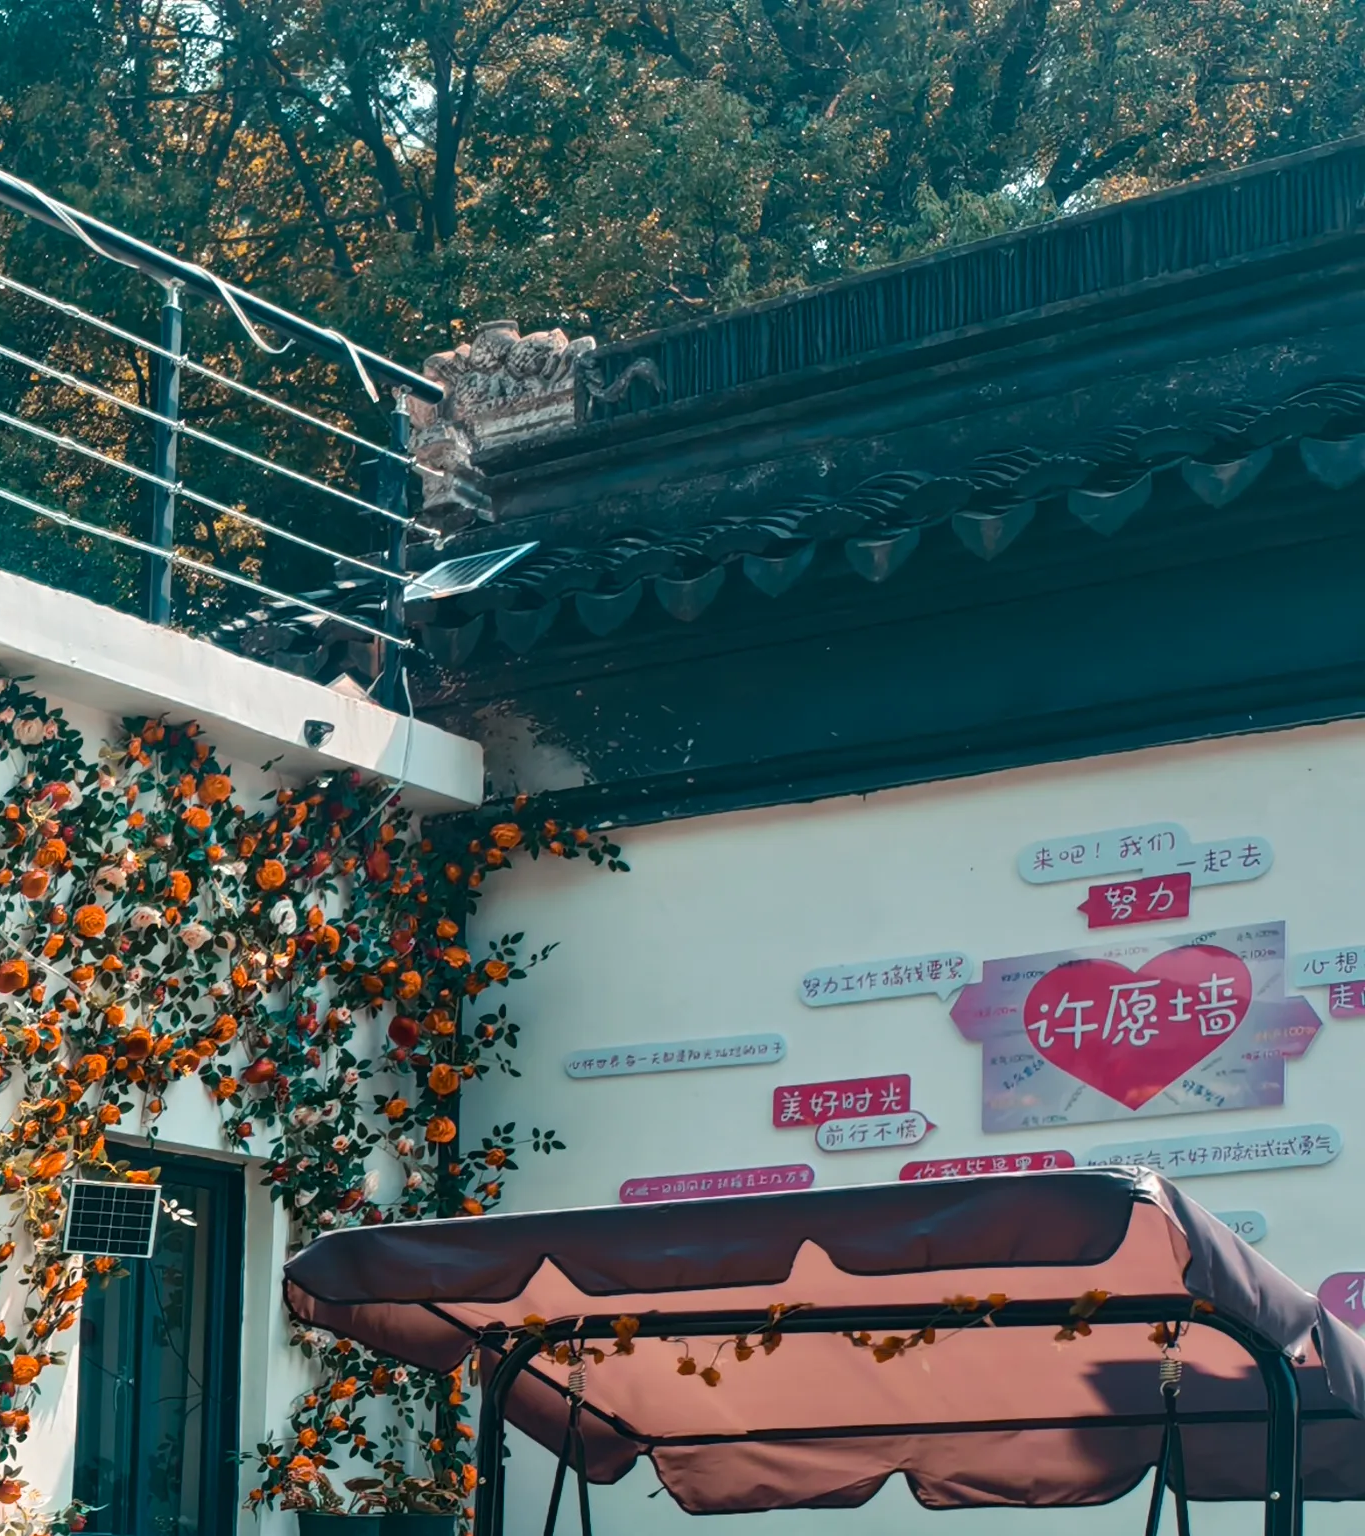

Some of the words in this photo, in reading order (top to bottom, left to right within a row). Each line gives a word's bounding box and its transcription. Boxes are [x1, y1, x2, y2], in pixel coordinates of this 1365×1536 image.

[1177, 843, 1262, 873] 一起去
[1104, 881, 1175, 921] 努力
[802, 956, 964, 998] 努力工作搞钱要紧
[1303, 951, 1365, 975] 心想
[1026, 972, 1239, 1050] 许愿墙
[1331, 984, 1365, 1010] 走
[779, 1081, 903, 1122] 美好时光
[824, 1117, 918, 1147] 前行不慌
